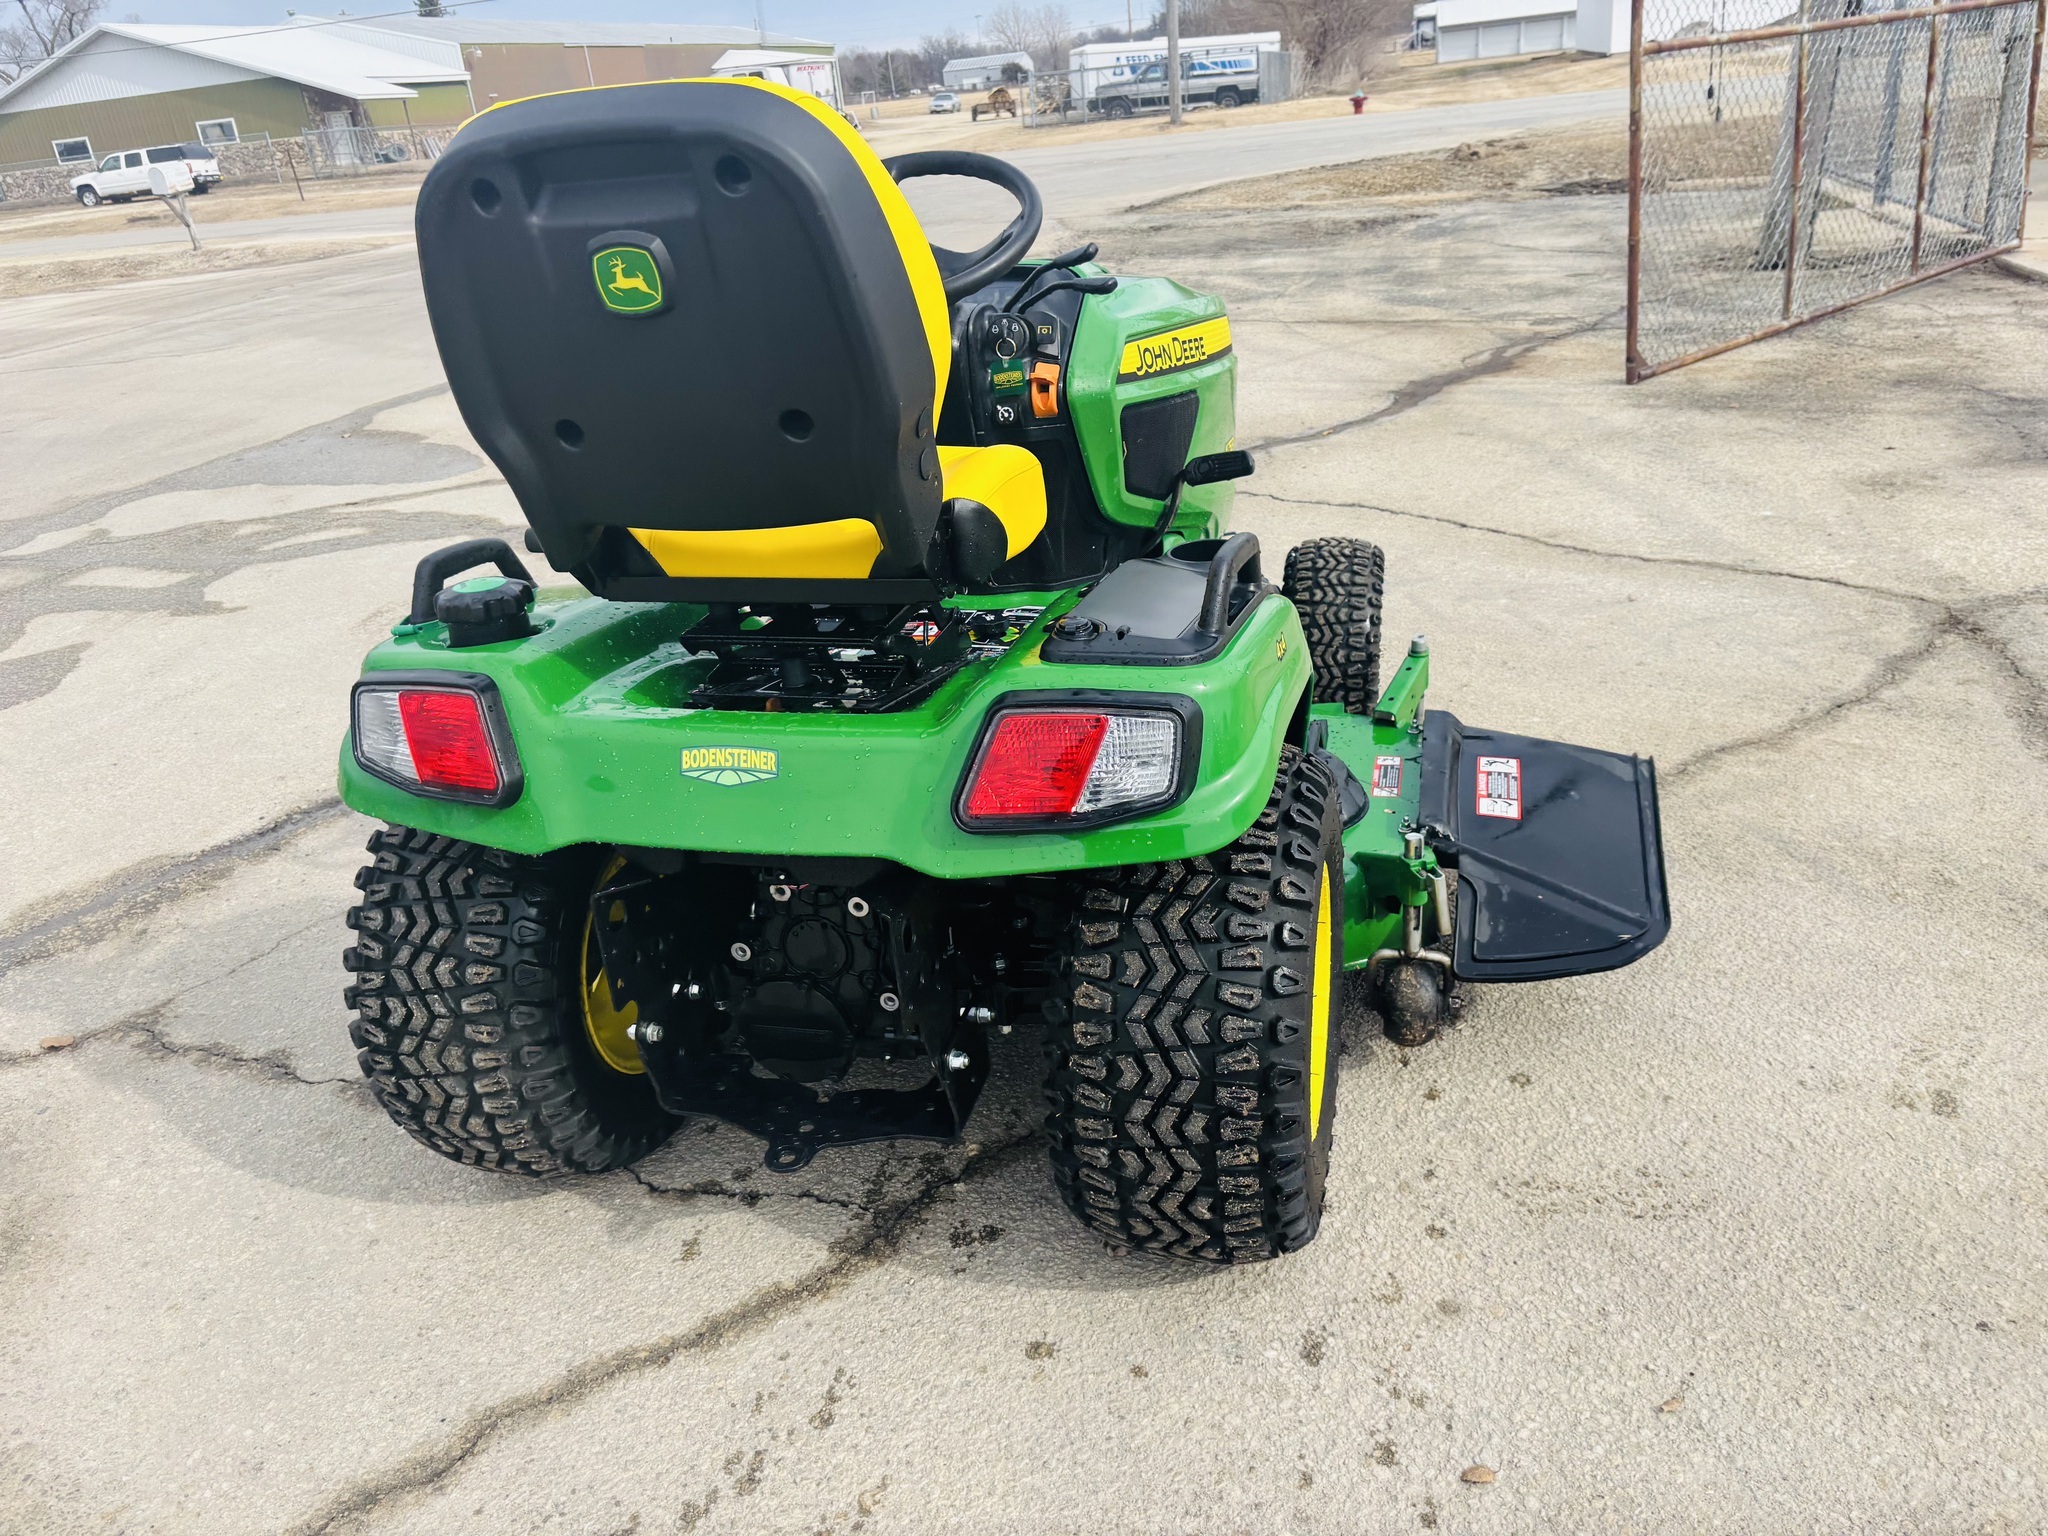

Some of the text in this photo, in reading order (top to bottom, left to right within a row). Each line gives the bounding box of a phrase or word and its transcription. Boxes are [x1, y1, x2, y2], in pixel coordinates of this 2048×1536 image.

[1136, 336, 1206, 373] JOHN DEERE
[682, 748, 776, 771] BODENSTEINER
